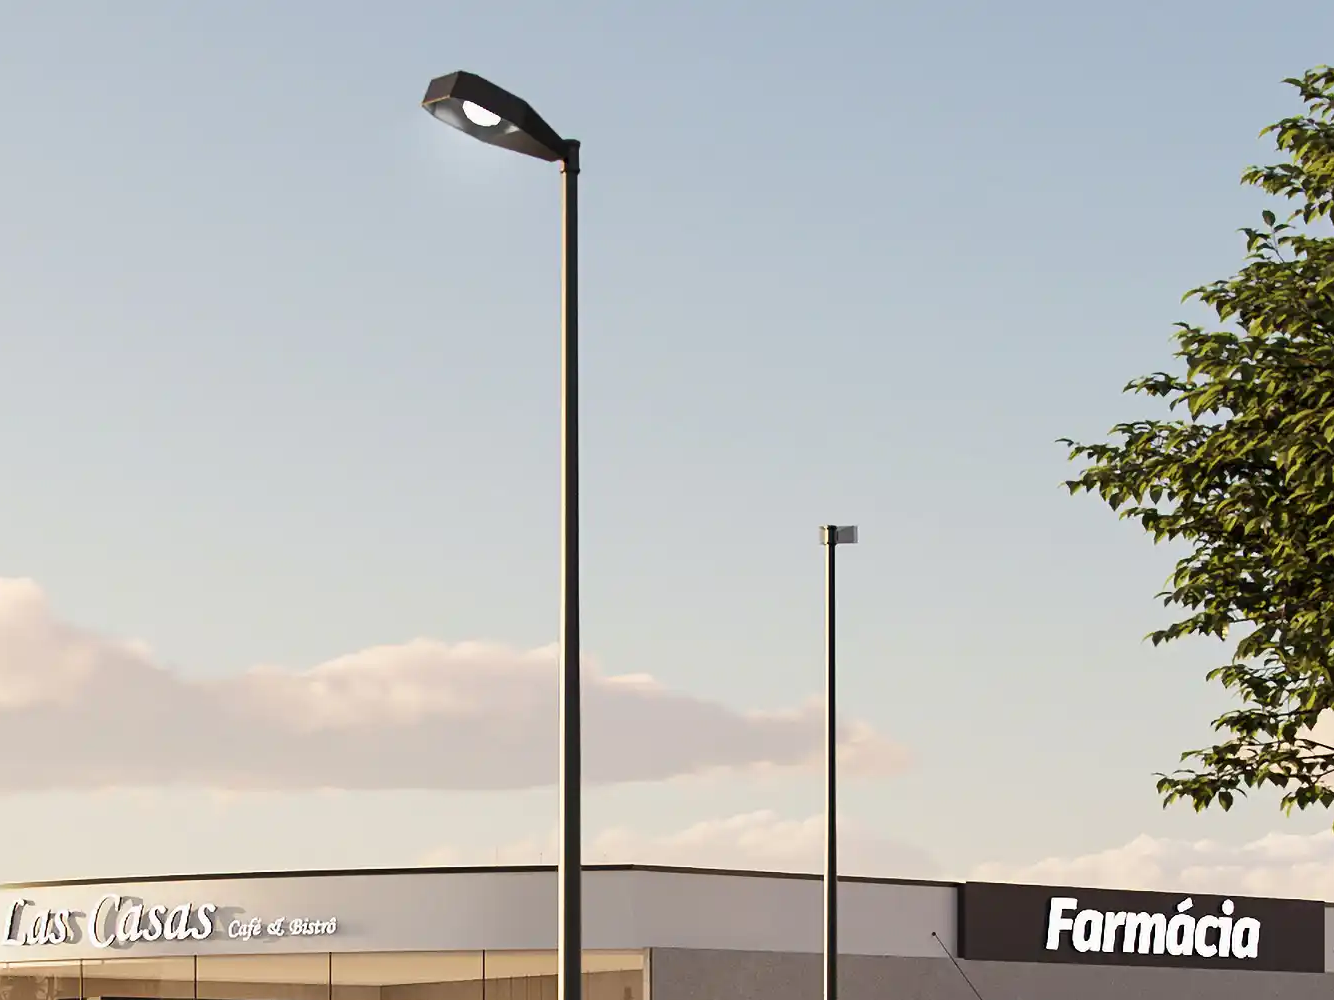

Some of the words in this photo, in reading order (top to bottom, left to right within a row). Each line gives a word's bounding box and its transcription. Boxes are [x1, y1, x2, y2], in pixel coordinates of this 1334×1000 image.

[1, 898, 69, 947] Las
[87, 893, 219, 949] Casas
[227, 916, 262, 939] Café
[289, 916, 339, 937] Bistrô
[1045, 896, 1261, 959] Farmácia
